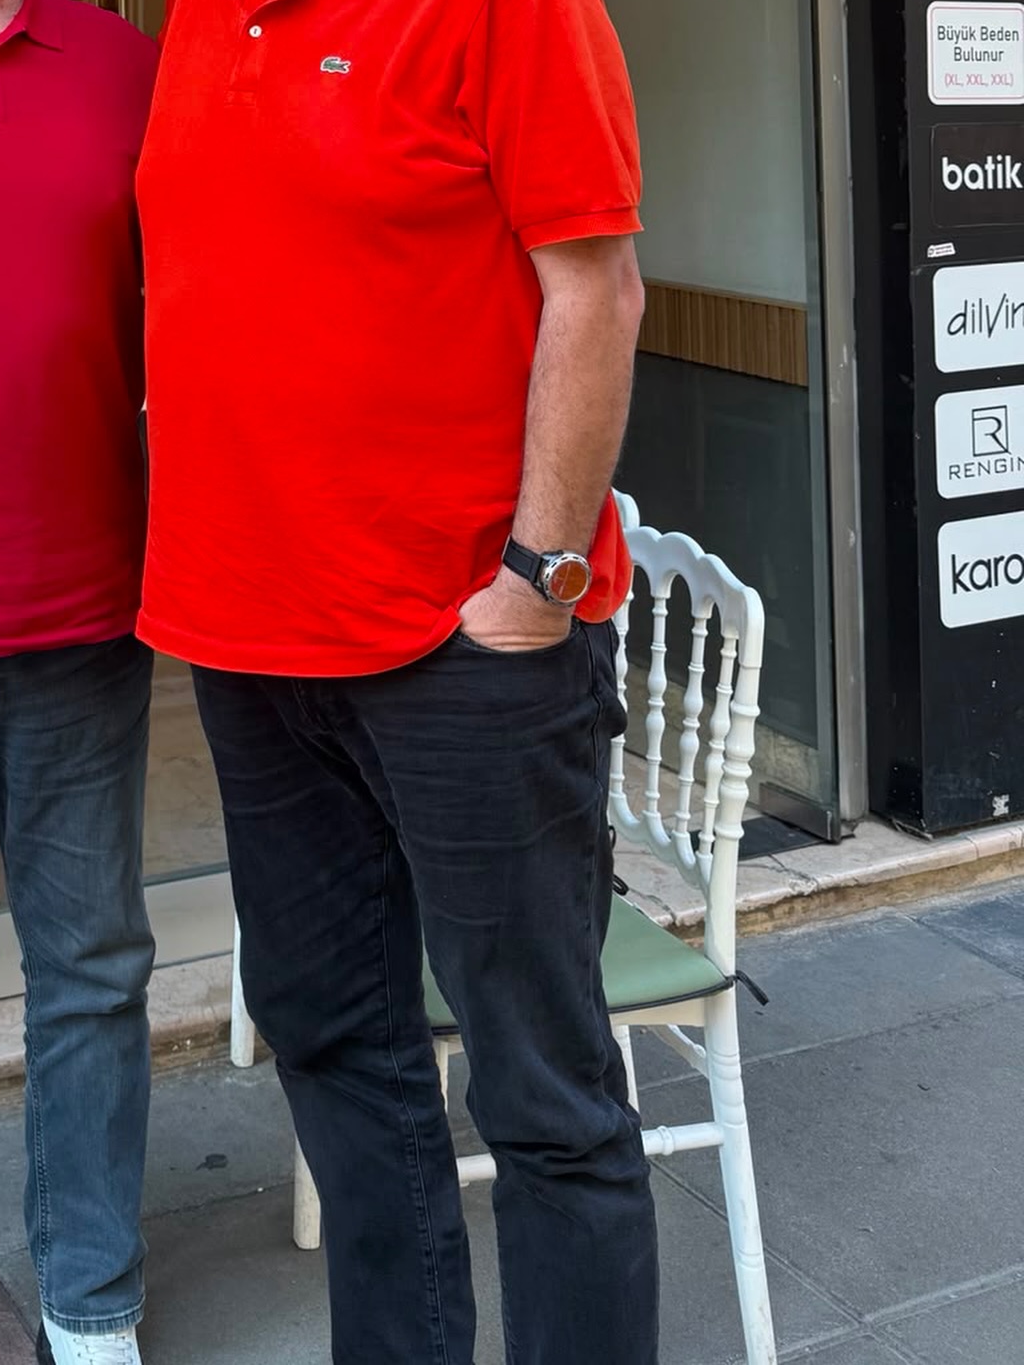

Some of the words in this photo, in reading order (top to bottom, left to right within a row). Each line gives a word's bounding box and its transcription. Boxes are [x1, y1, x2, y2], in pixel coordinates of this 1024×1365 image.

[937, 25, 976, 44] Büyük
[980, 26, 1019, 41] Beden
[954, 46, 1004, 62] Bulunur
[942, 154, 1023, 191] batik
